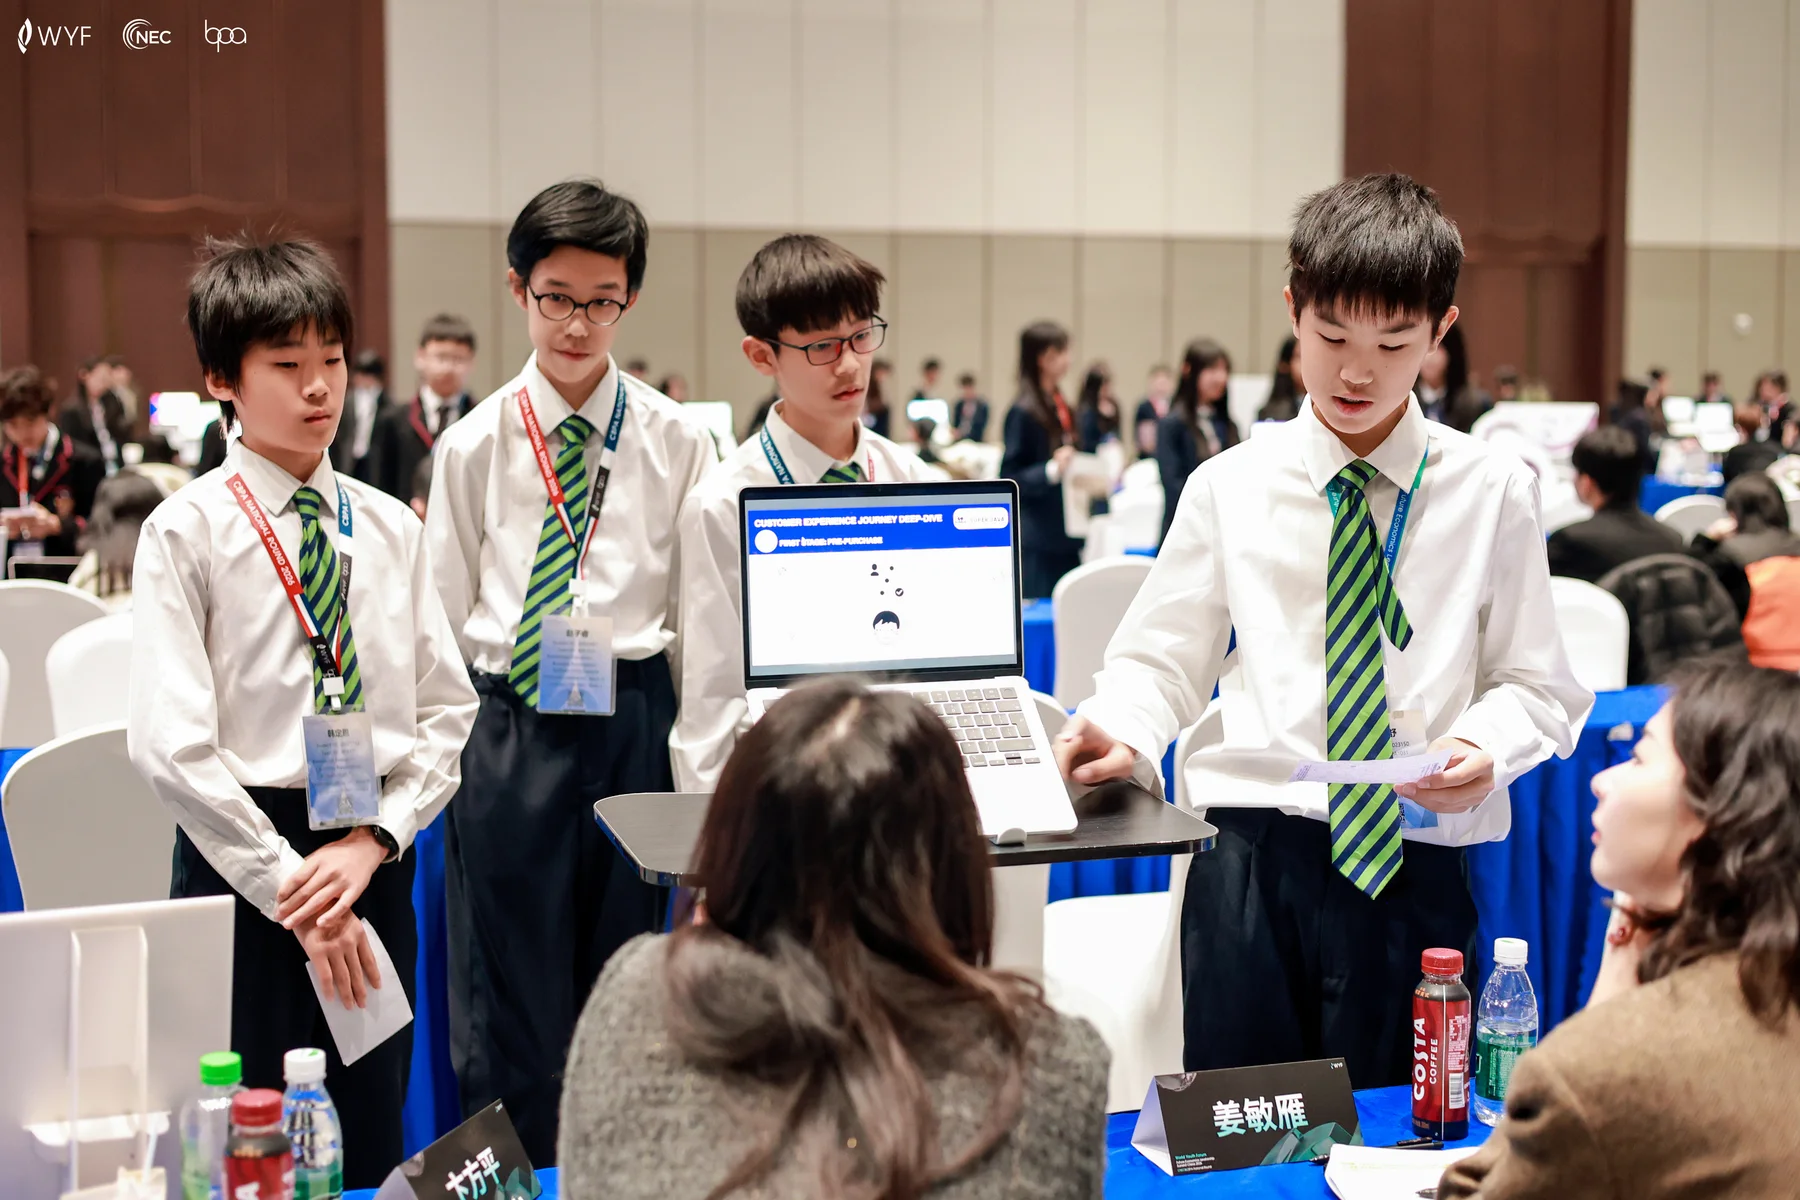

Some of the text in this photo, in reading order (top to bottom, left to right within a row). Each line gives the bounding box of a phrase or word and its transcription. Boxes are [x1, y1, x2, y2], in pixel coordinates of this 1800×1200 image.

[233, 480, 295, 586] CBPA NATIONAL ROUND 2026
[754, 513, 943, 528] CUSTOMER EXPERIENCE JOURNEY DEEP-DIVE
[1387, 513, 1403, 552] Economics
[1413, 1017, 1429, 1100] COSTA
[1429, 1039, 1438, 1085] COFFEE
[1212, 1092, 1308, 1138] 姜敏雁
